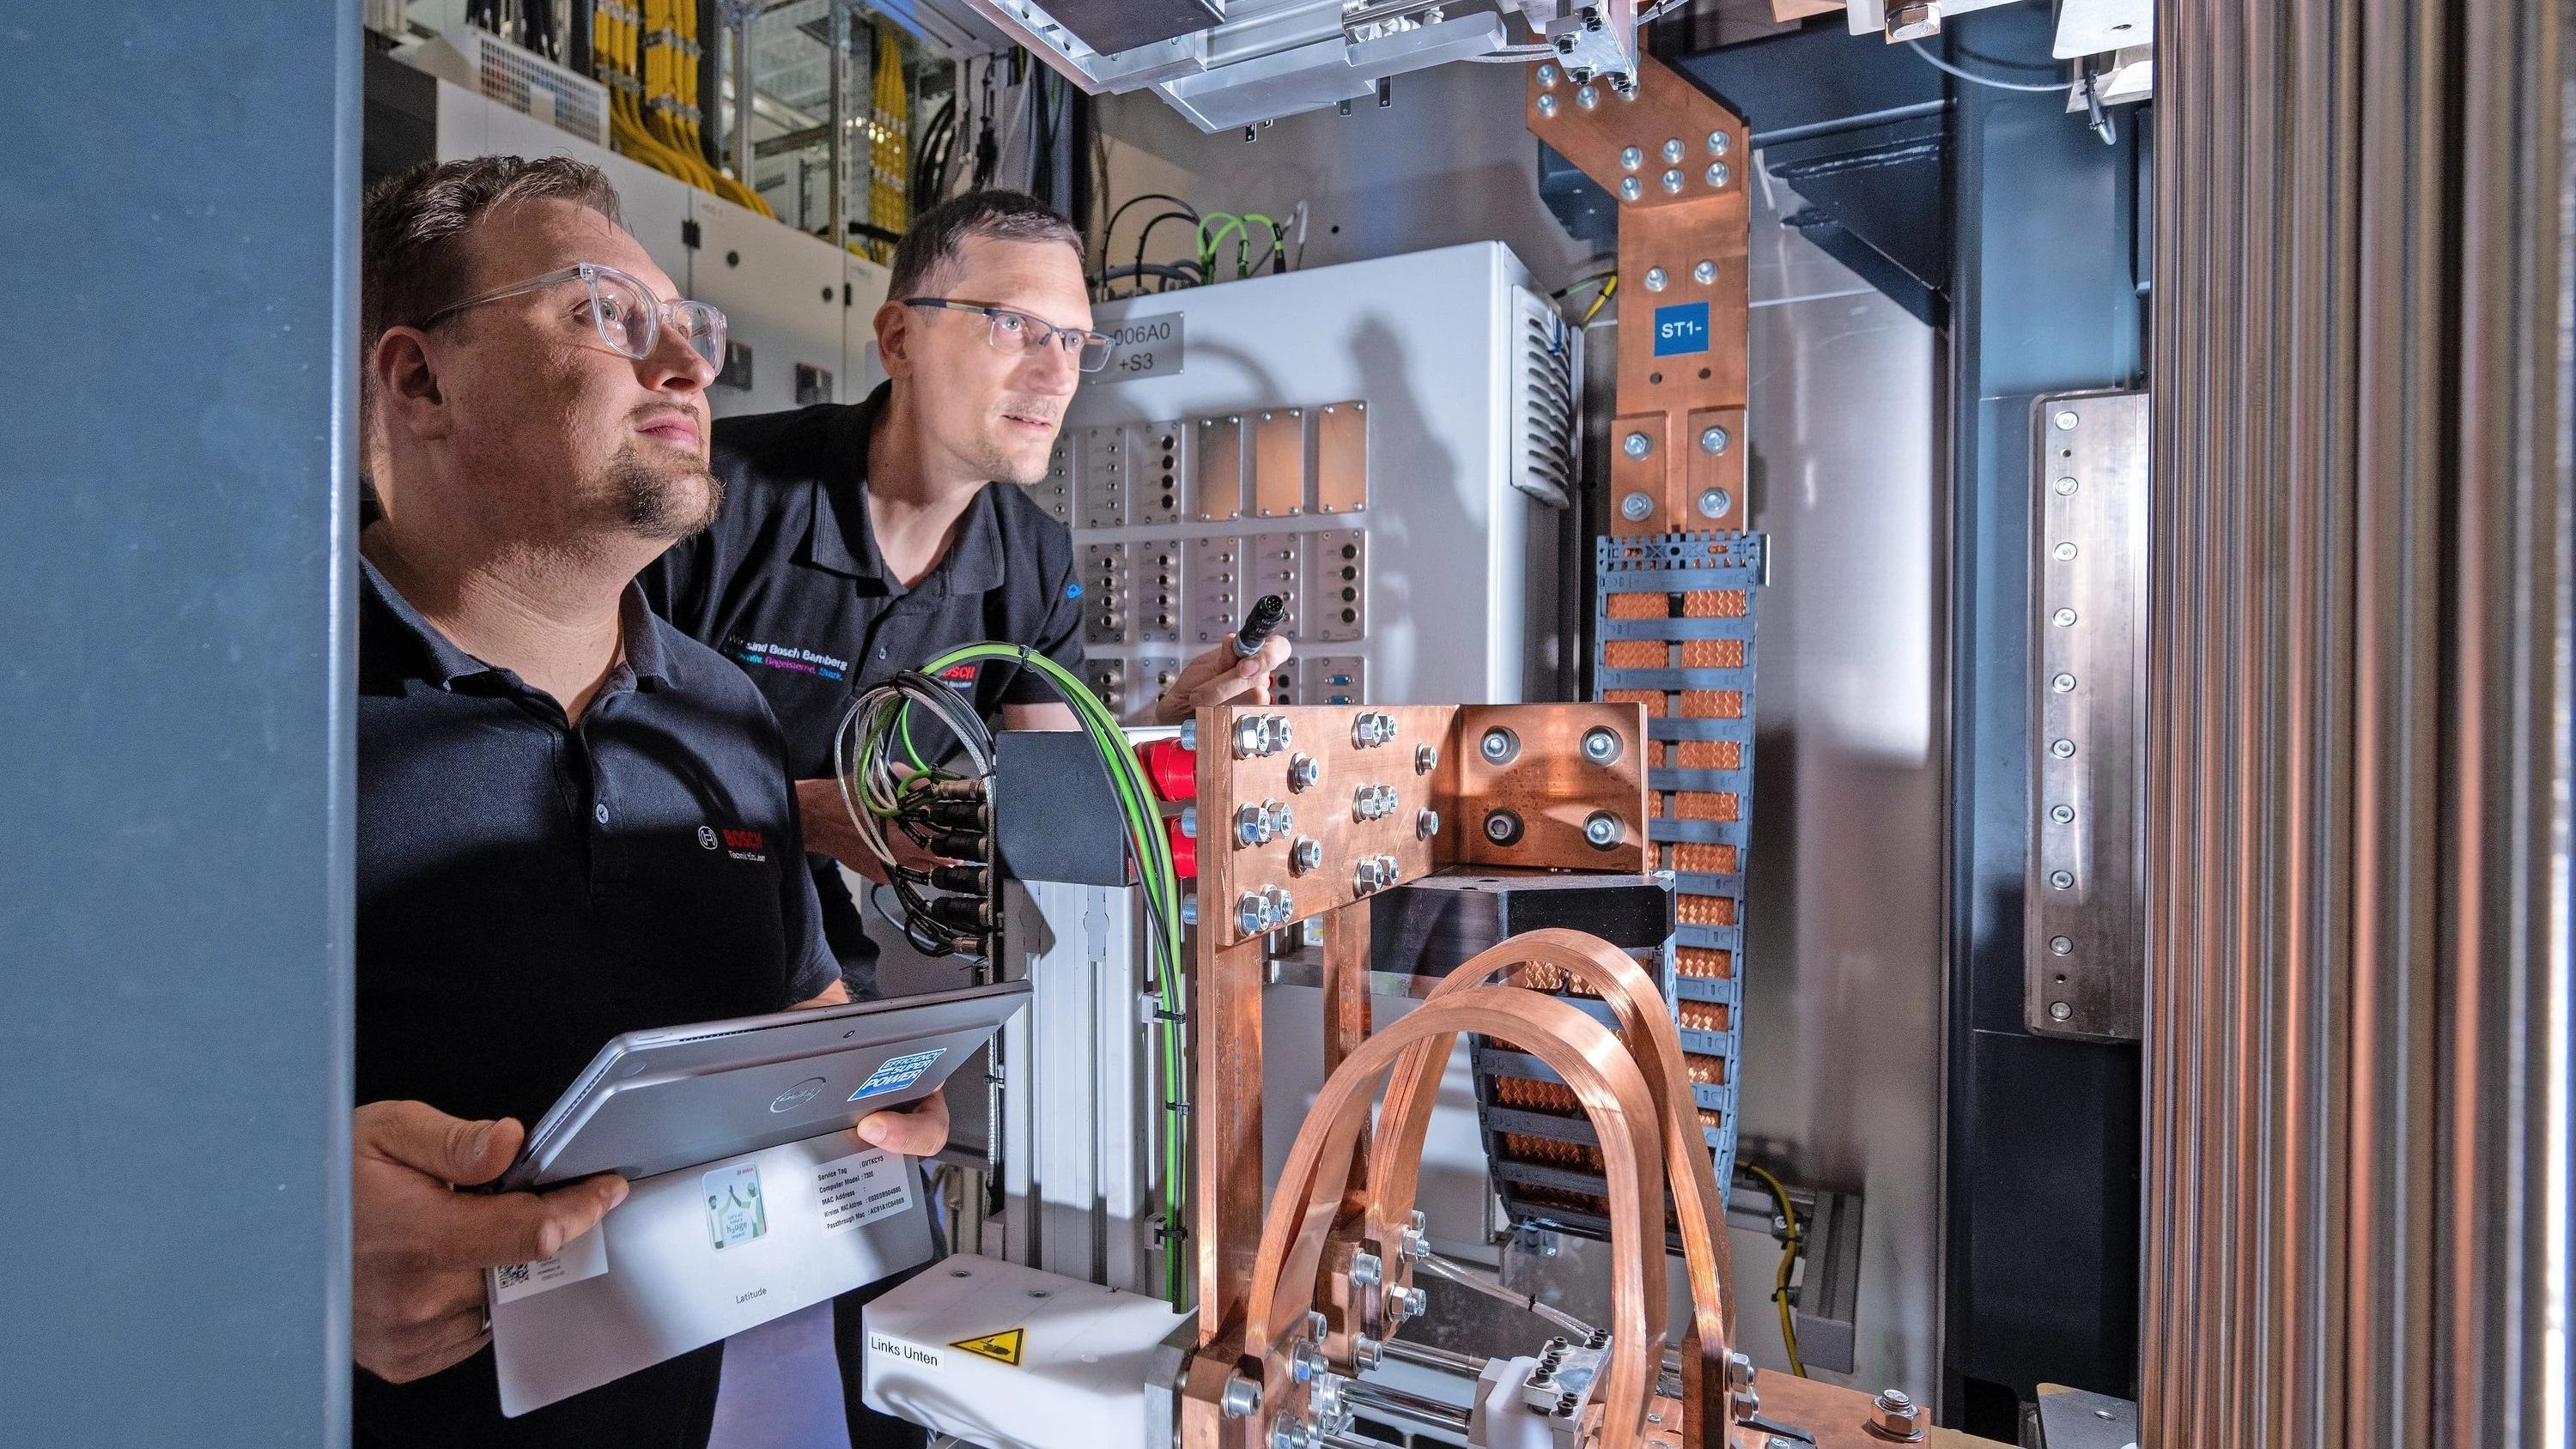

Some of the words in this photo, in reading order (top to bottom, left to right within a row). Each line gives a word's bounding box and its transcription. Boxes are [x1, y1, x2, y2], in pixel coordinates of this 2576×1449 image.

[1662, 320, 1702, 338] ST1-
[1119, 353, 1153, 372] +S3
[746, 642, 768, 653] sind
[769, 644, 800, 659] Bosch
[802, 650, 848, 671] Bamberg
[722, 828, 762, 850] BOSCH
[883, 1051, 942, 1069] EFFICIENCY
[891, 1059, 932, 1075] SUPER
[861, 1069, 923, 1090] POWER
[817, 1170, 837, 1181] Service
[819, 1180, 843, 1193] Computer
[844, 1175, 860, 1185] Model
[822, 1195, 835, 1206] MAC
[835, 1190, 855, 1201] Address
[736, 1287, 767, 1304] Latitude
[871, 1336, 901, 1356] Links
[903, 1345, 938, 1367] Unten
